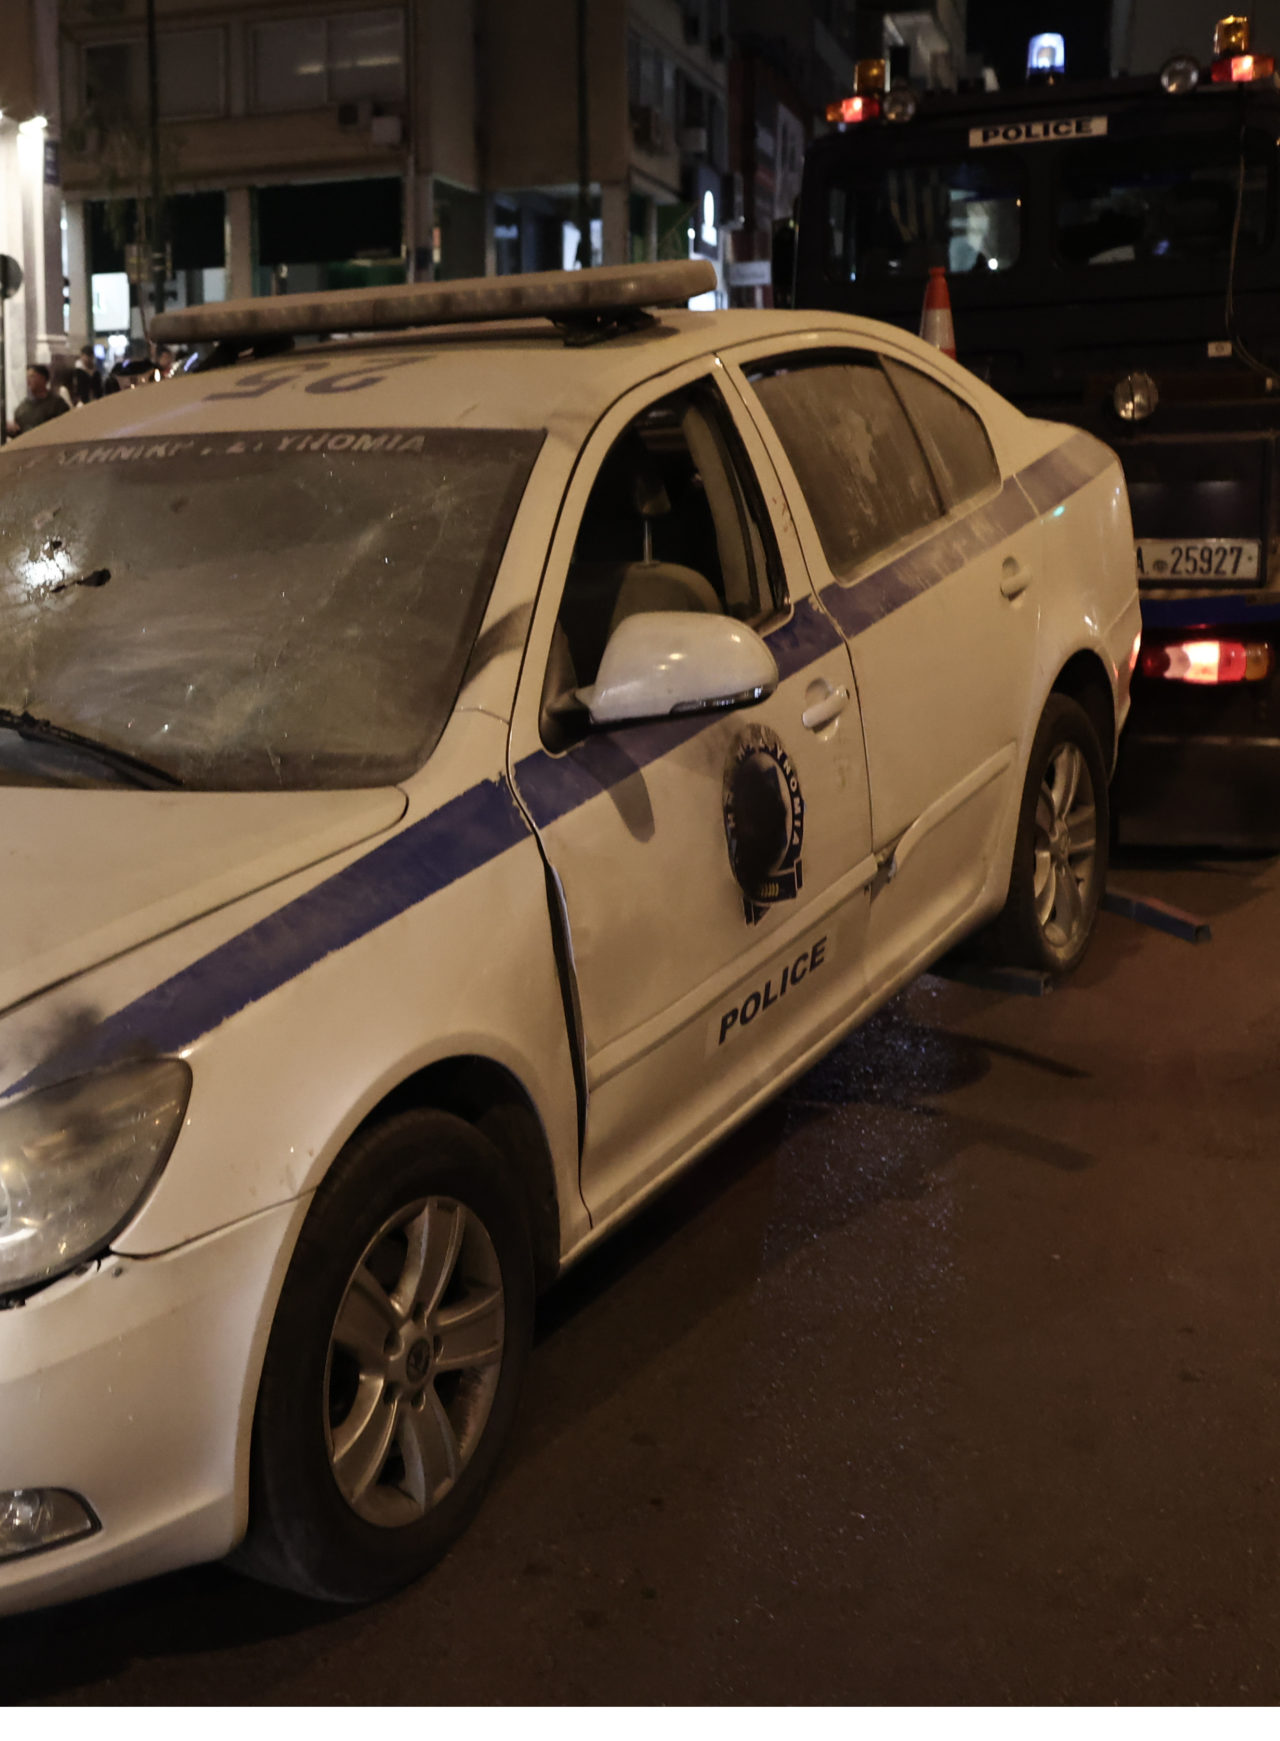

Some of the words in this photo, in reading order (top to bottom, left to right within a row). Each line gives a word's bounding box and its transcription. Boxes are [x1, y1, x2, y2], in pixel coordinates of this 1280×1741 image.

[982, 119, 1093, 143] POLICE
[1171, 546, 1243, 576] 25927
[719, 936, 827, 1046] POLICE
